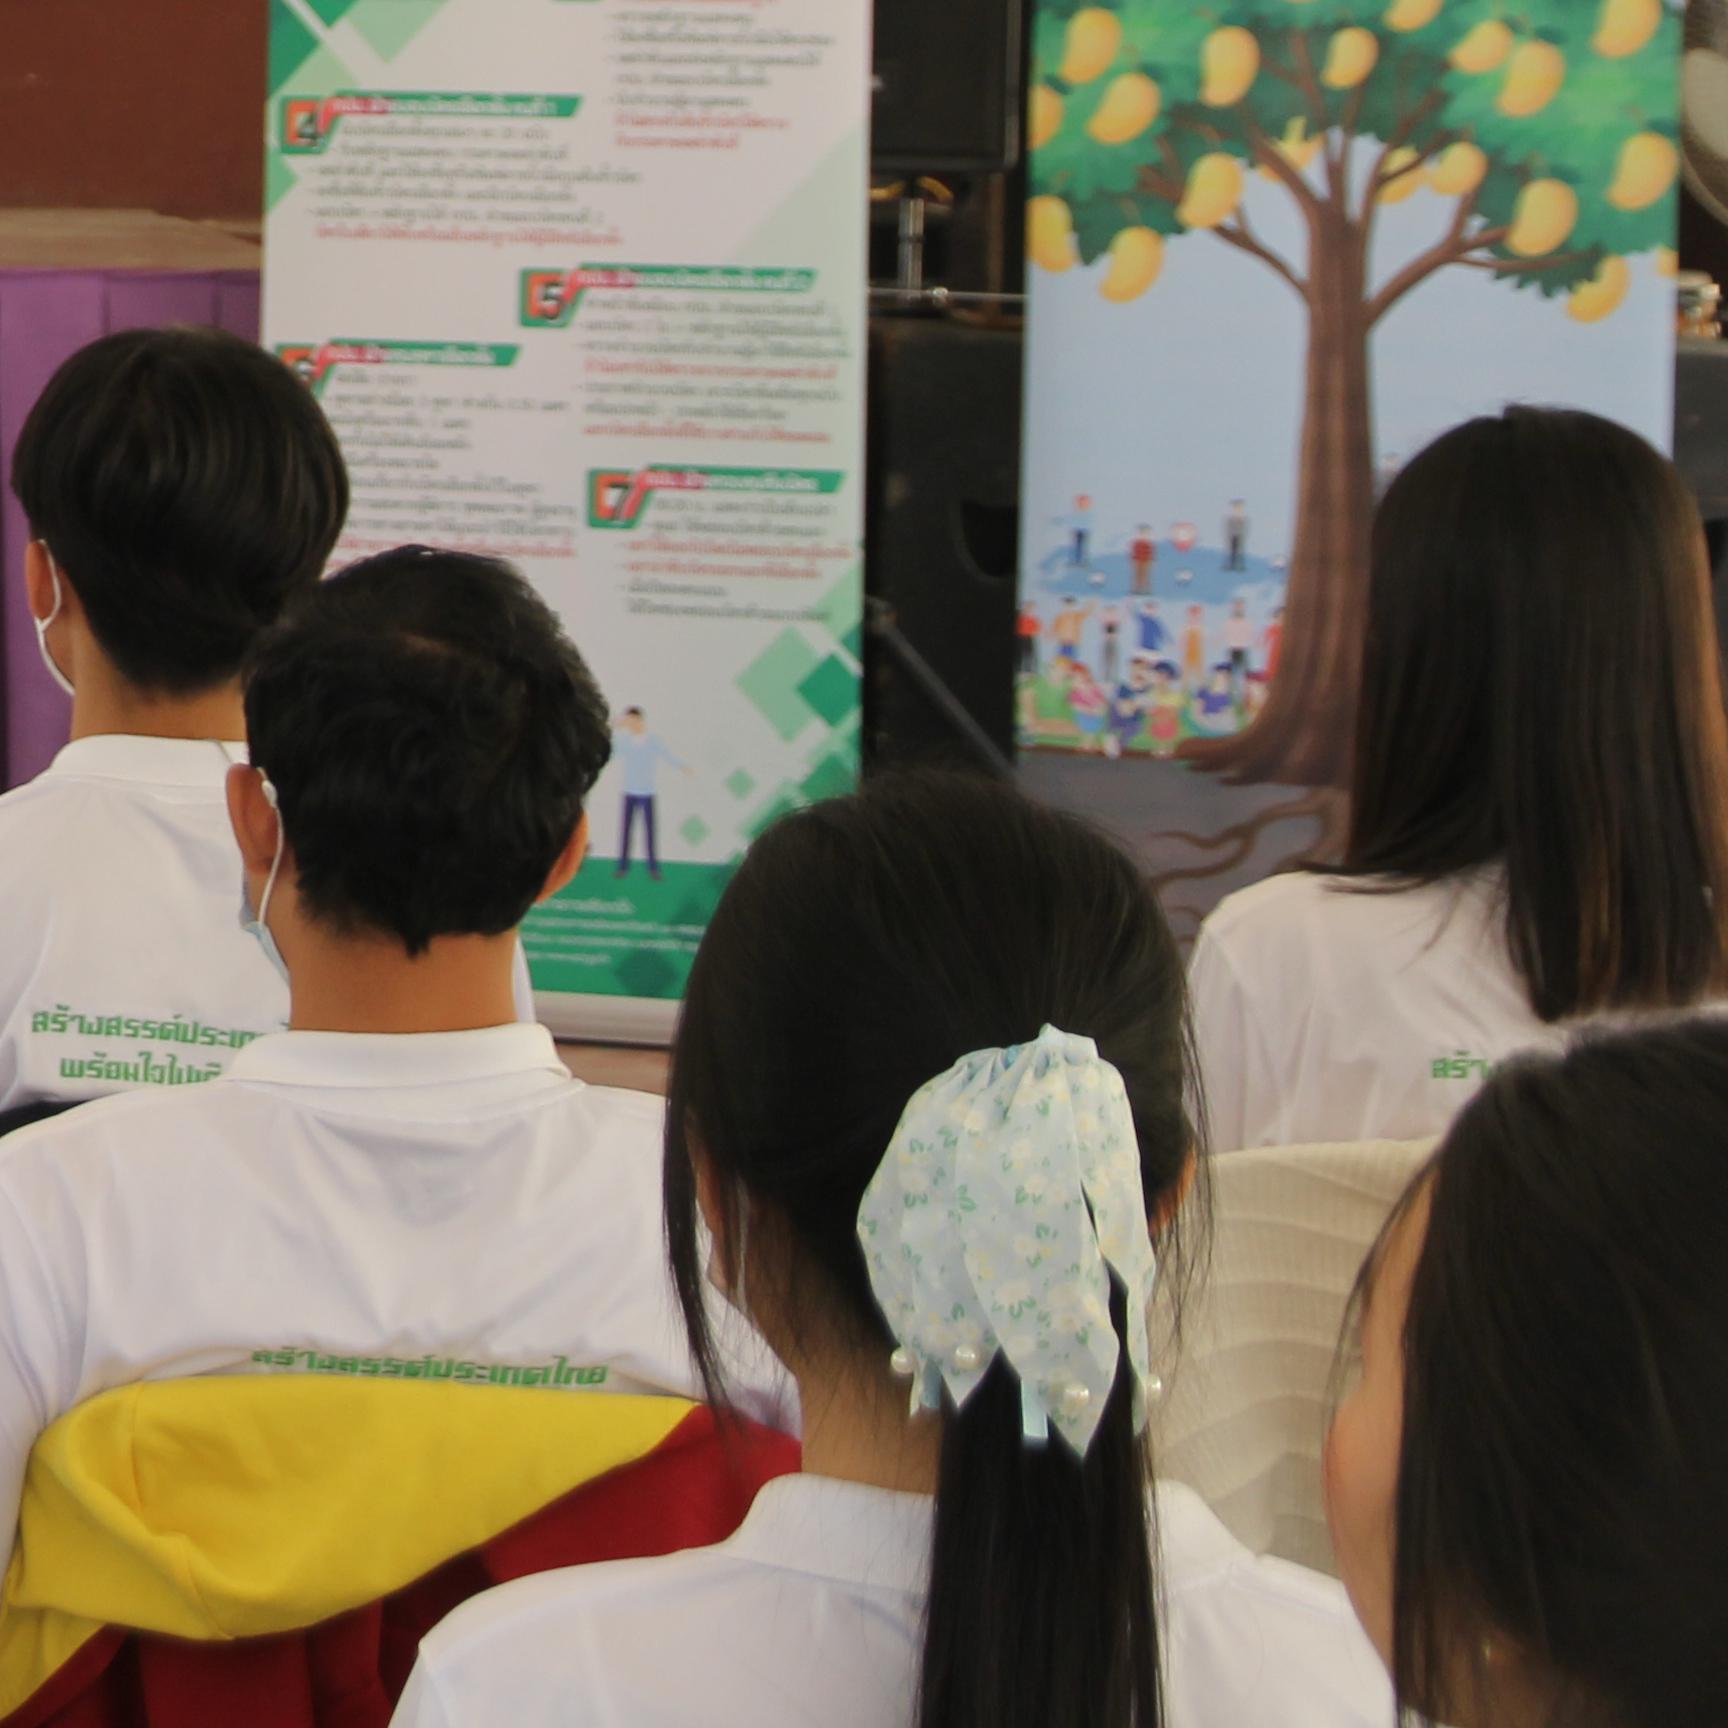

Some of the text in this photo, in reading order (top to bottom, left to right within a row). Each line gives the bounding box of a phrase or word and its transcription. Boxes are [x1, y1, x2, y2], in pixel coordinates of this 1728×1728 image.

[31, 1003, 266, 1049] สร้างสรรค์ประเท
